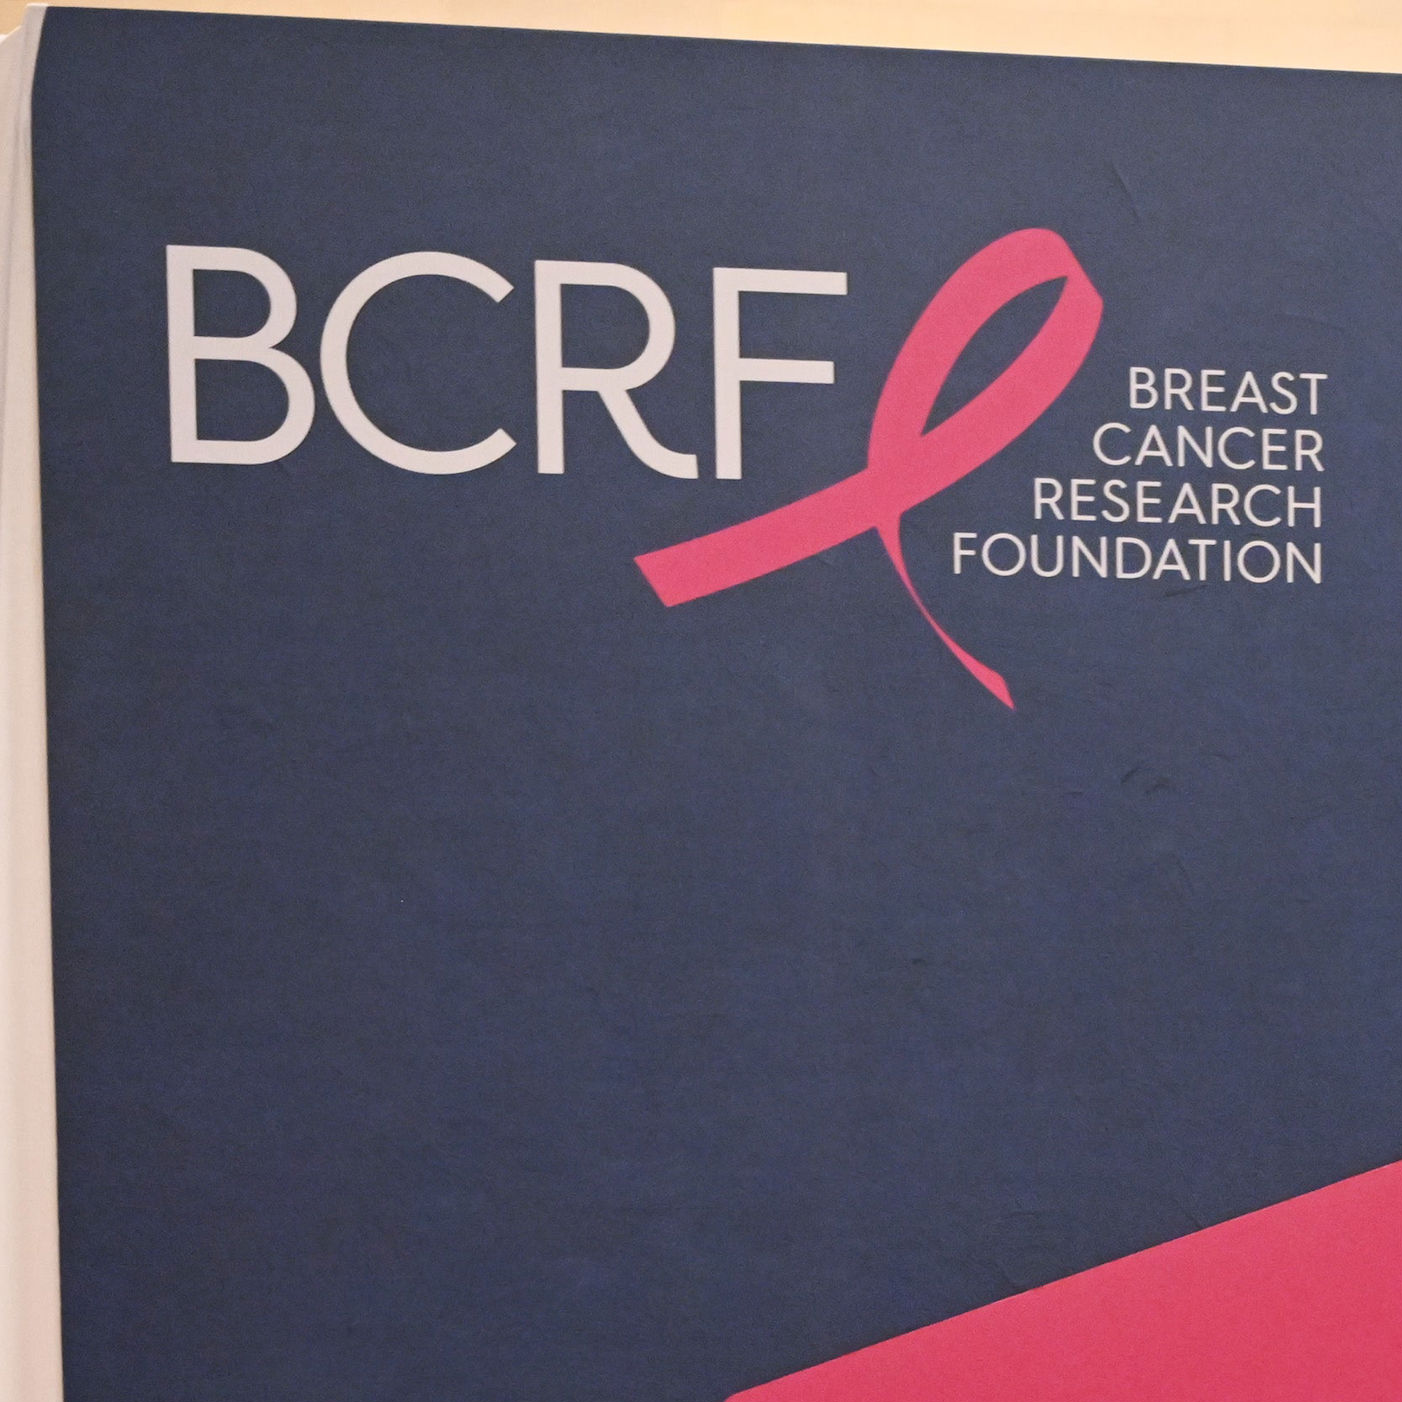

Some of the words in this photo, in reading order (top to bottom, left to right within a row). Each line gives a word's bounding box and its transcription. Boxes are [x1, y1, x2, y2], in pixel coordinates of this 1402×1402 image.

[166, 245, 847, 479] BCRF
[1130, 367, 1328, 415] BREAST
[1093, 423, 1324, 471] CANCER
[1034, 478, 1321, 527] RESEARCH
[954, 532, 1321, 584] FOUNDATION
